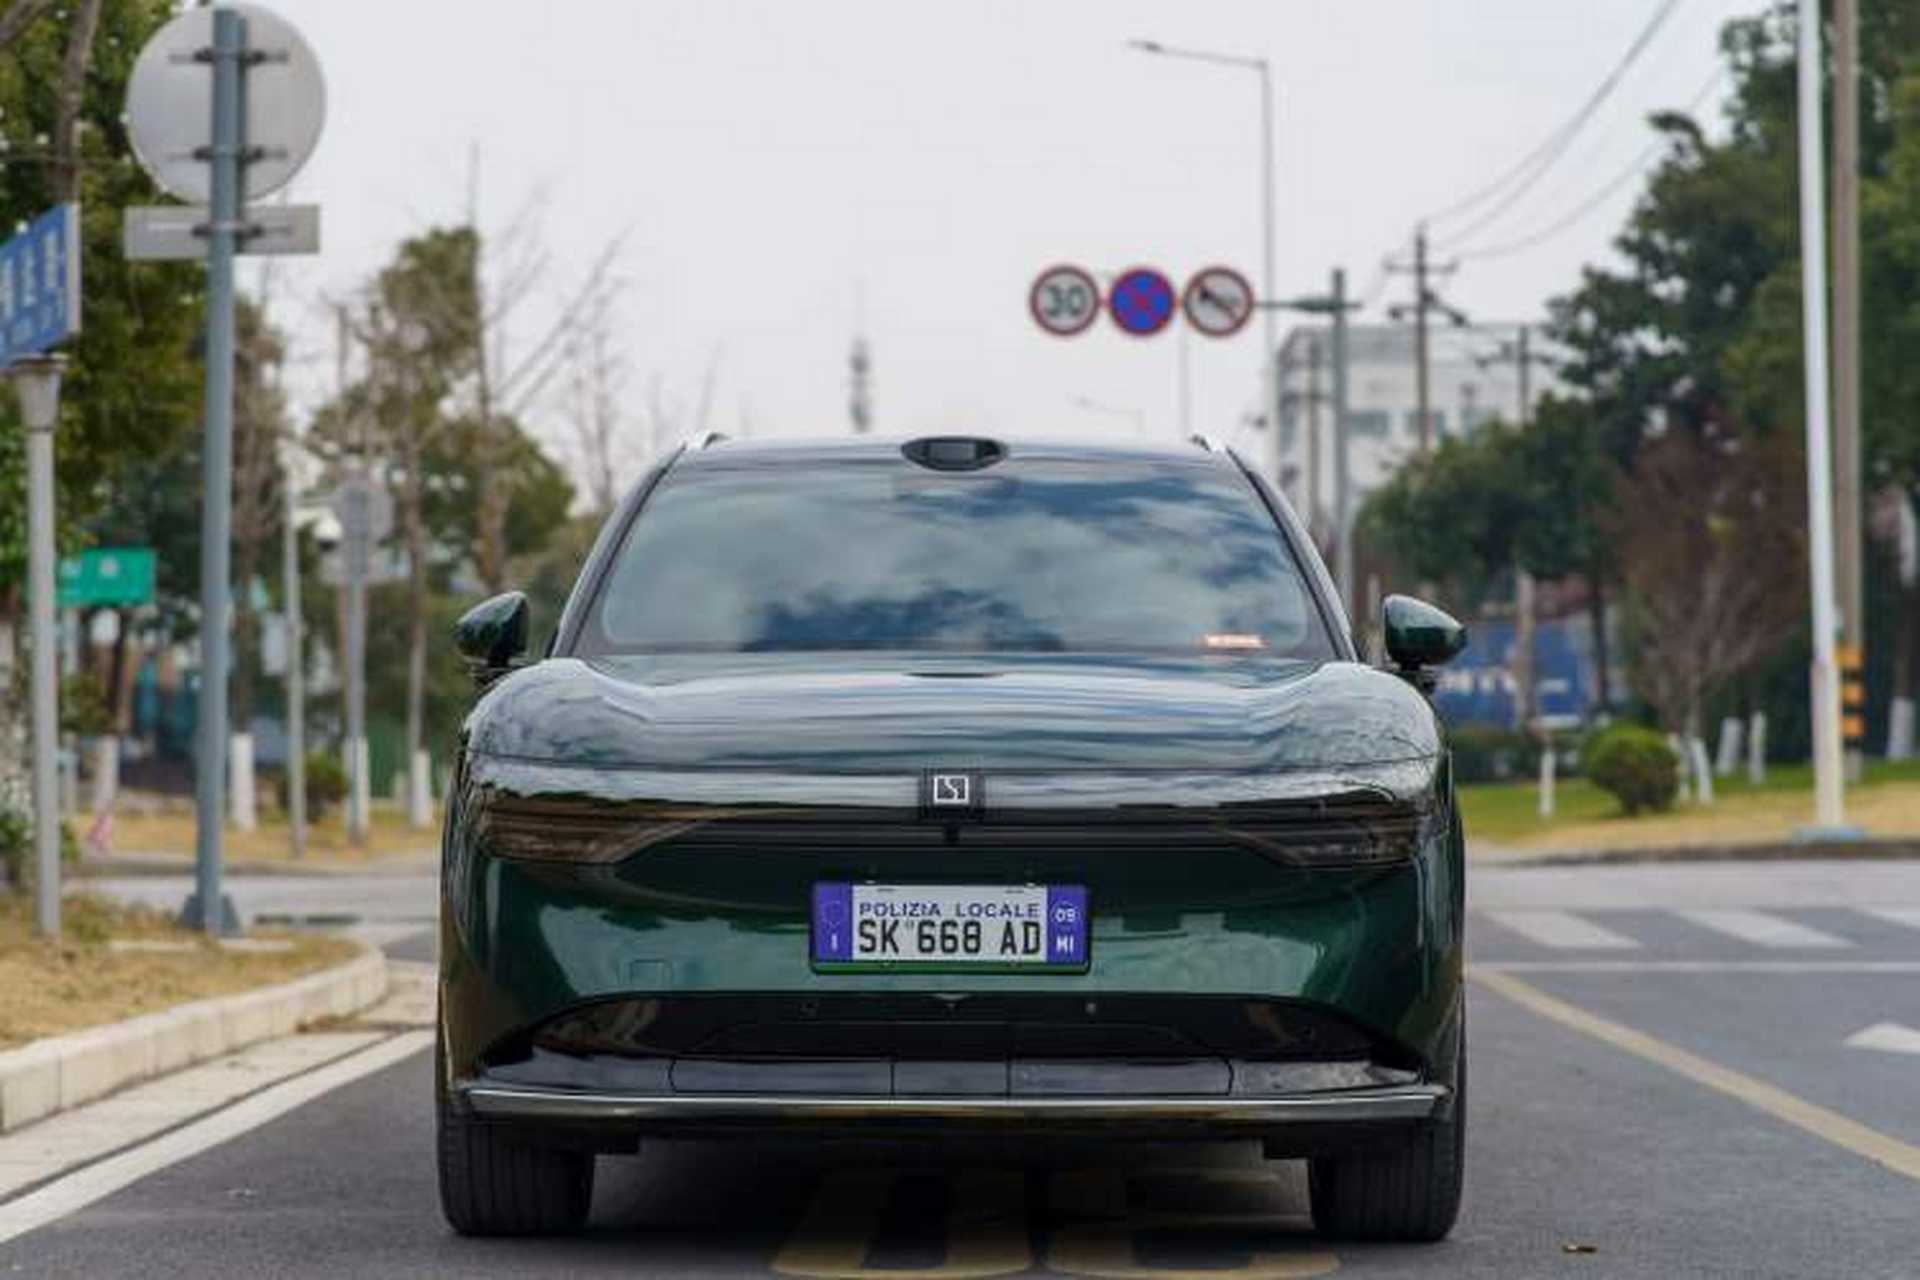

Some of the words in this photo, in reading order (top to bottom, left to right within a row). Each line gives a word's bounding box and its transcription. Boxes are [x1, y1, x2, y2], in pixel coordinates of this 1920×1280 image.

[1045, 284, 1088, 318] 30
[858, 902, 942, 917] POLIZIA
[955, 902, 1040, 917] LOCALE
[858, 919, 900, 954] SK
[917, 919, 982, 954] 668
[1000, 919, 1041, 954] AD
